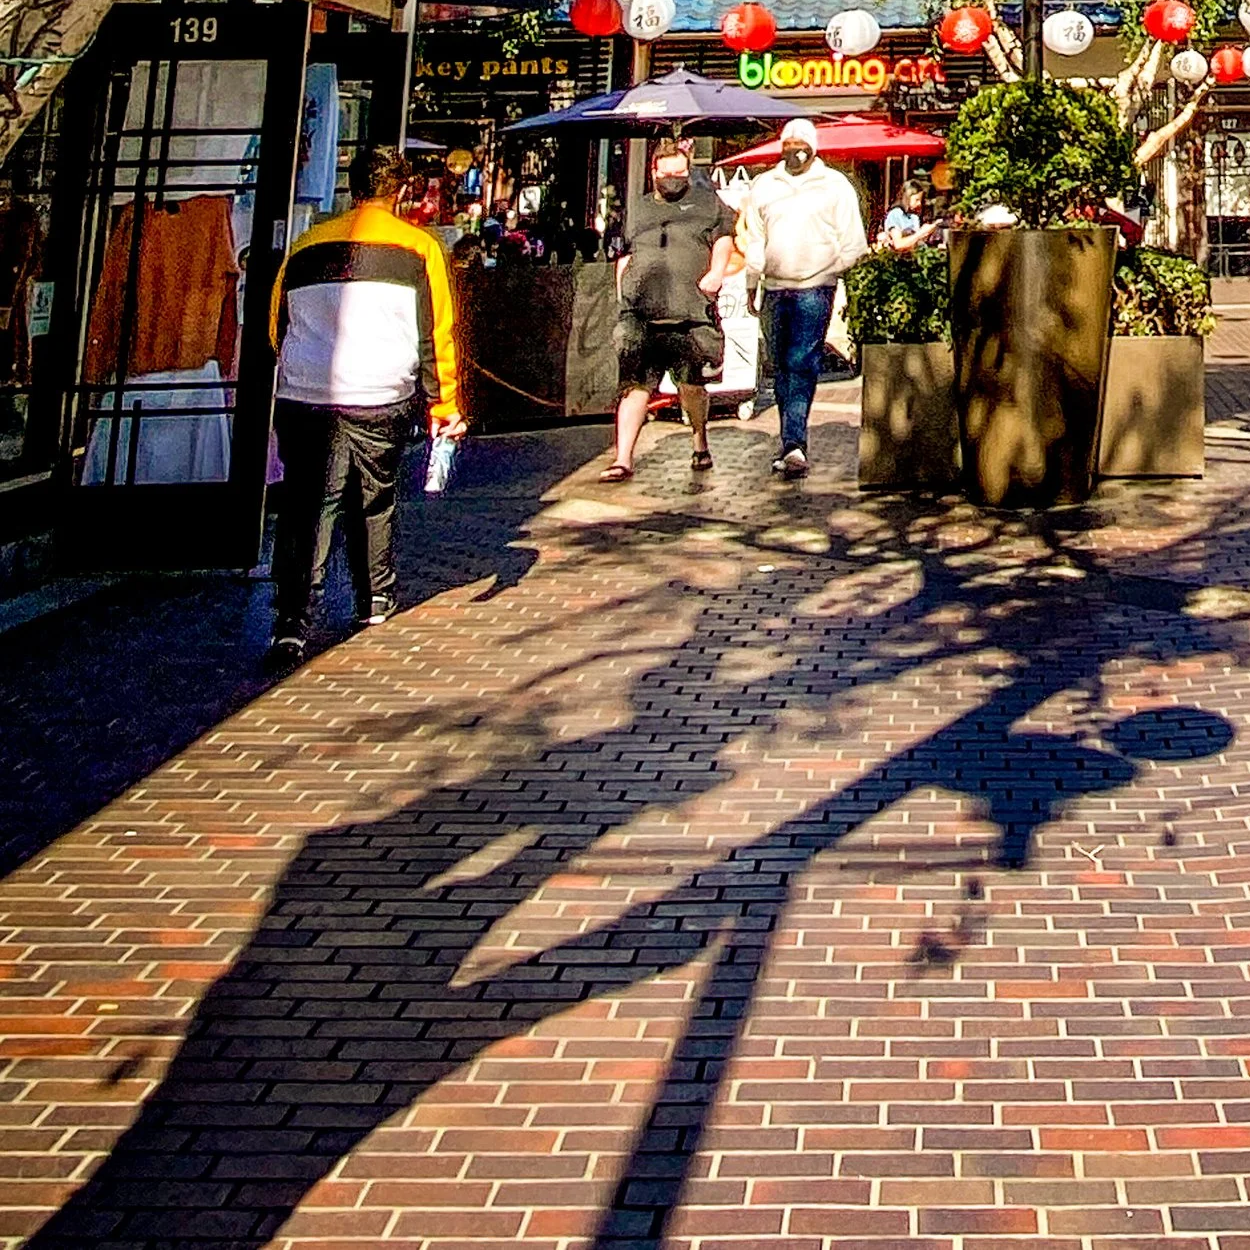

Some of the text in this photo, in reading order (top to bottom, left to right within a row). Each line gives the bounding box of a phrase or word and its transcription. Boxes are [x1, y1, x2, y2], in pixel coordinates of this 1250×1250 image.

[169, 17, 218, 43] 139
[479, 56, 569, 81] pants
[738, 51, 887, 92] blooming
